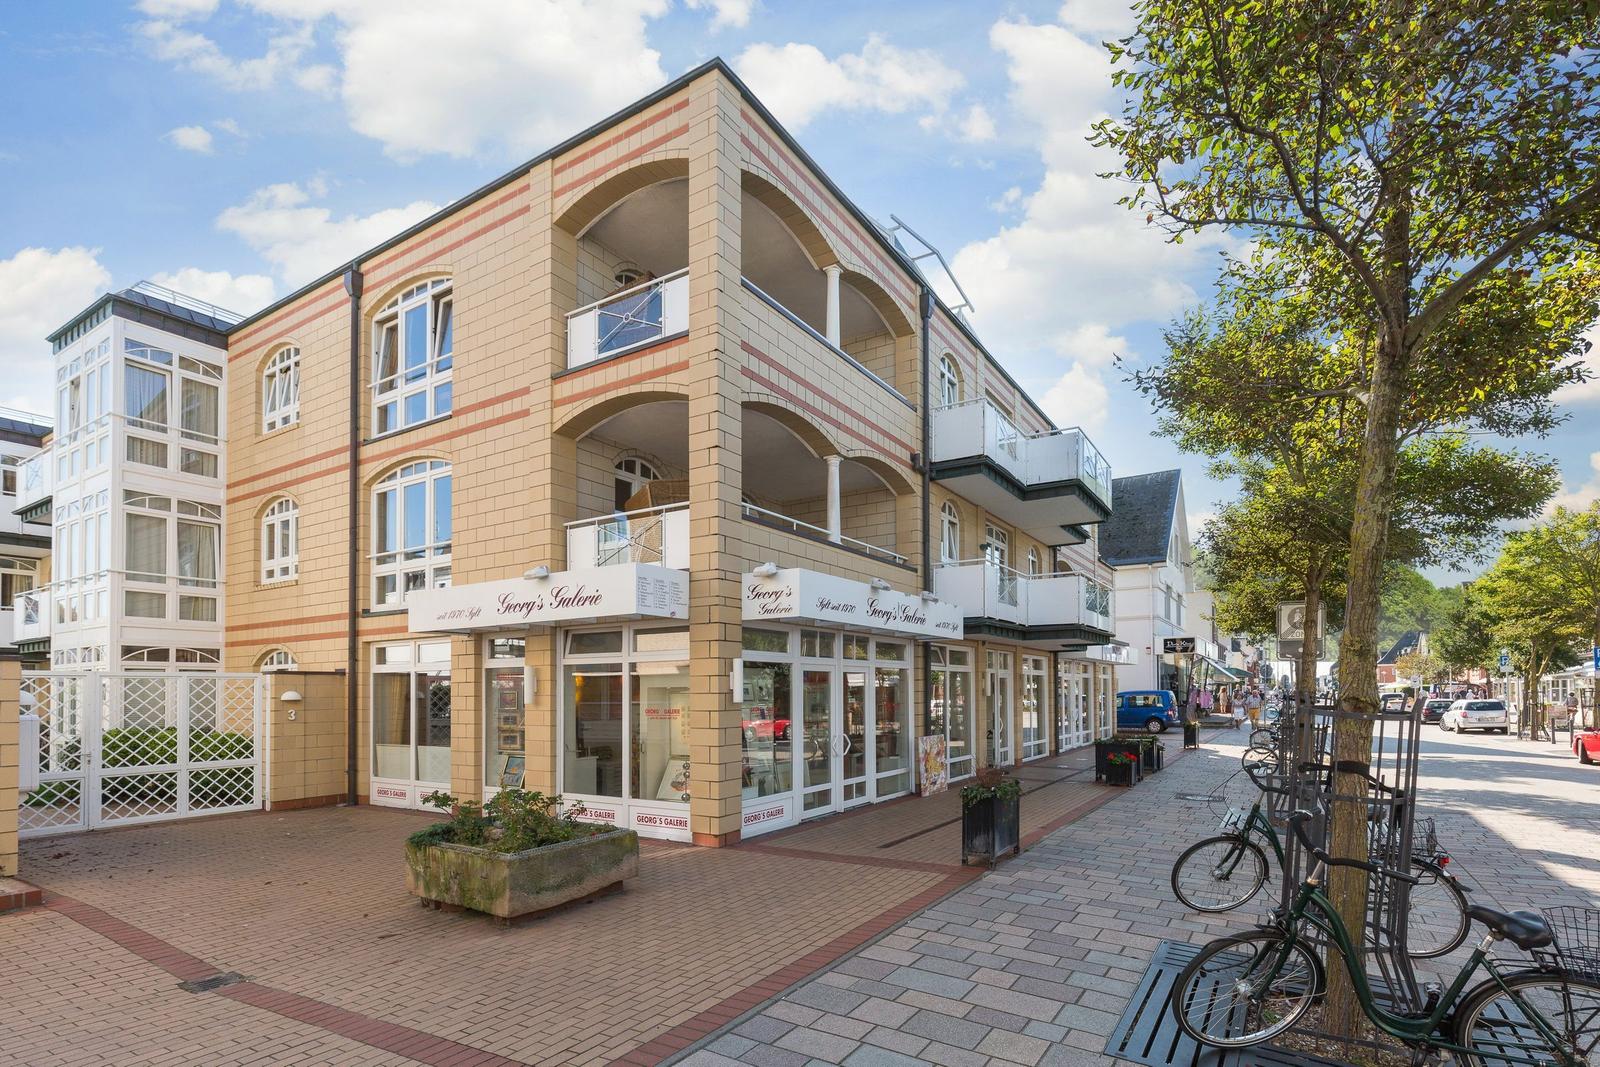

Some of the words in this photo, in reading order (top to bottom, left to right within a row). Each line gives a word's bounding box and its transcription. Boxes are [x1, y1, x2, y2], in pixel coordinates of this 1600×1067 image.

[747, 583, 792, 603] Georg's
[497, 592, 544, 619] Georg's
[550, 584, 603, 610] Galerie
[758, 602, 793, 616] Galerie
[866, 597, 897, 626] Georg's
[900, 604, 927, 625] Galerie
[288, 709, 296, 721] 3
[593, 810, 616, 820] GALERIE
[766, 807, 784, 819] GALERIE
[664, 818, 688, 827] GALERIE
